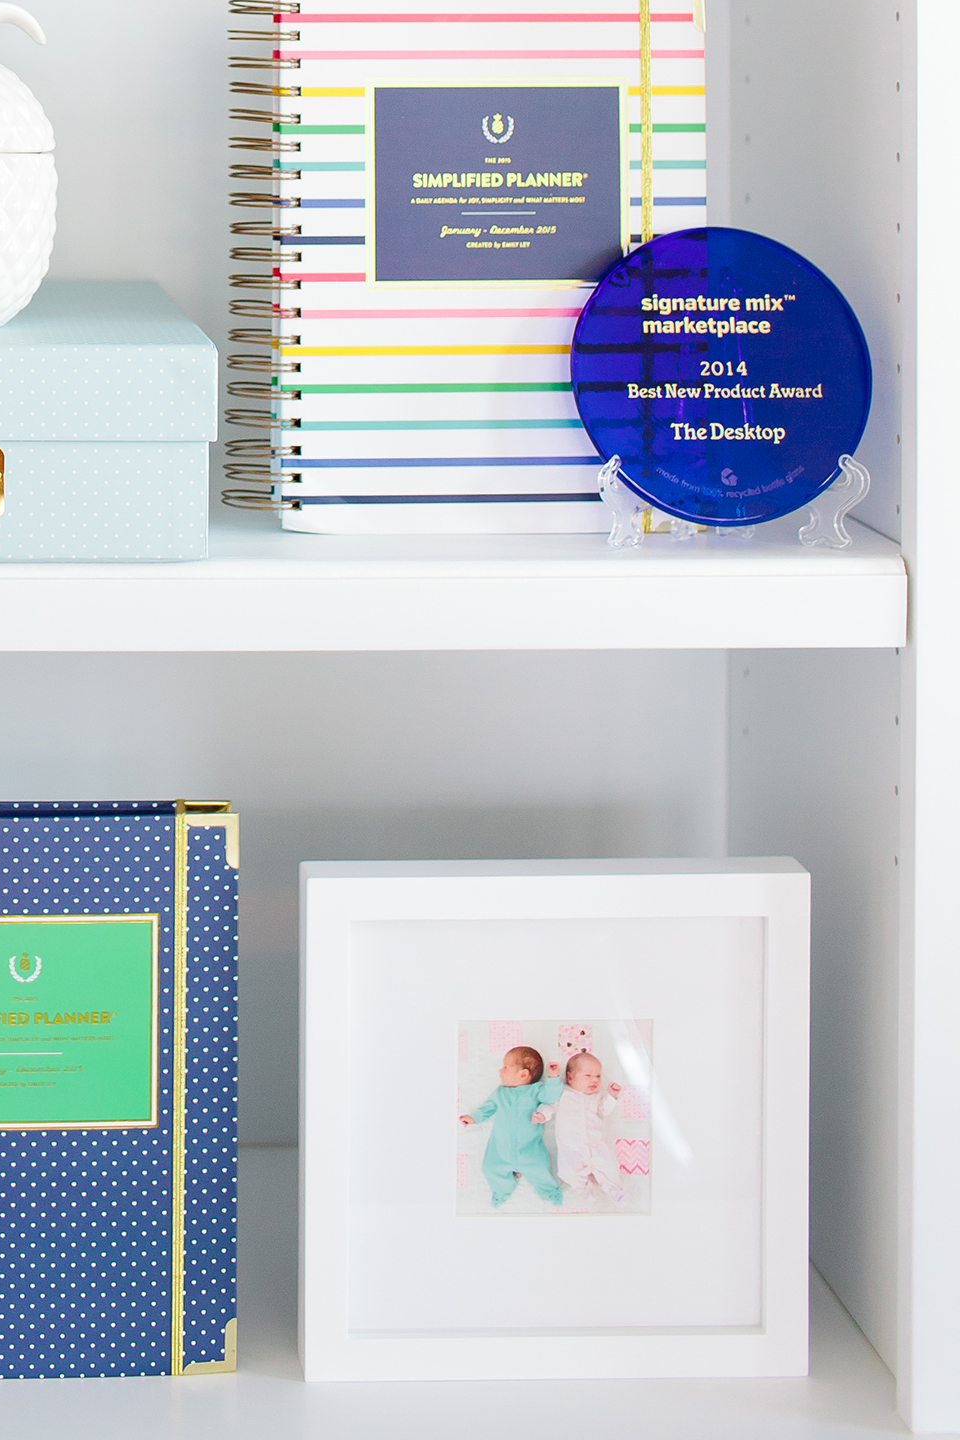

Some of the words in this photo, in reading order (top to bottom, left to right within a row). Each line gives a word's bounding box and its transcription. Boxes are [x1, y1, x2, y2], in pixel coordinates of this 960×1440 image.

[412, 173, 504, 188] SIMPLIFIED
[513, 196, 525, 204] and
[543, 196, 569, 204] MATTERS
[440, 225, 482, 238] January
[489, 225, 534, 235] December
[535, 225, 557, 234] 2015
[466, 241, 493, 249] CREATED
[493, 241, 501, 249] by
[641, 294, 741, 316] signature
[642, 316, 771, 338] marketplace
[699, 360, 748, 377] 2014
[627, 383, 663, 399] Best
[664, 383, 702, 399] New
[703, 383, 766, 399] Product
[768, 383, 823, 399] Award
[670, 422, 708, 441] The
[709, 422, 786, 444] Desktop
[655, 466, 680, 484] made
[680, 479, 701, 493] from
[725, 486, 762, 499] recycled
